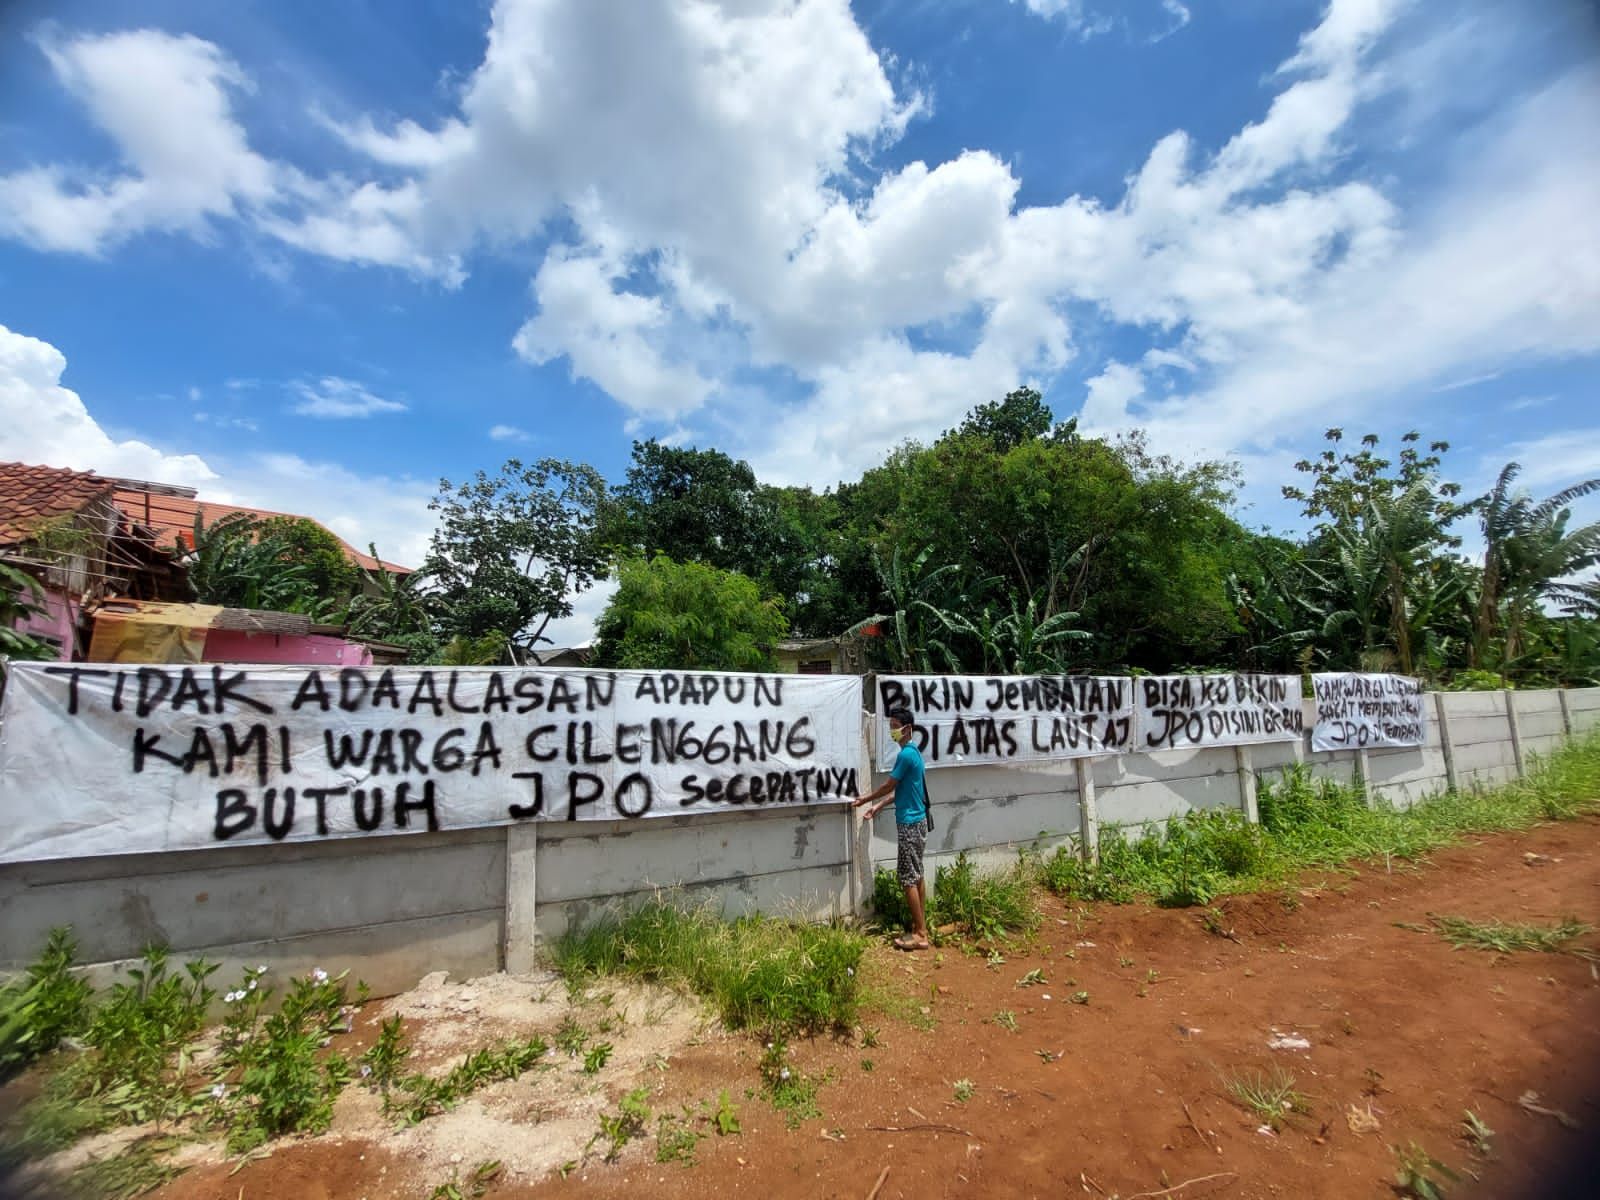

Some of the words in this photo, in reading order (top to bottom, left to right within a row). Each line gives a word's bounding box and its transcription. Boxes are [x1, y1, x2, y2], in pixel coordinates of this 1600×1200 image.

[45, 666, 275, 718] TIDAK
[635, 673, 783, 708] APAPUN
[880, 677, 974, 717] BIKIN
[947, 716, 1017, 756] ATAS
[1032, 715, 1098, 753] LAUT
[1147, 710, 1204, 748] JPO
[1331, 721, 1369, 746] JPO
[133, 724, 291, 786] KAMI
[325, 720, 502, 776] WARGA
[527, 715, 815, 766] CILENGGANG
[214, 780, 438, 840] BUTUH
[508, 771, 652, 822] JPO
